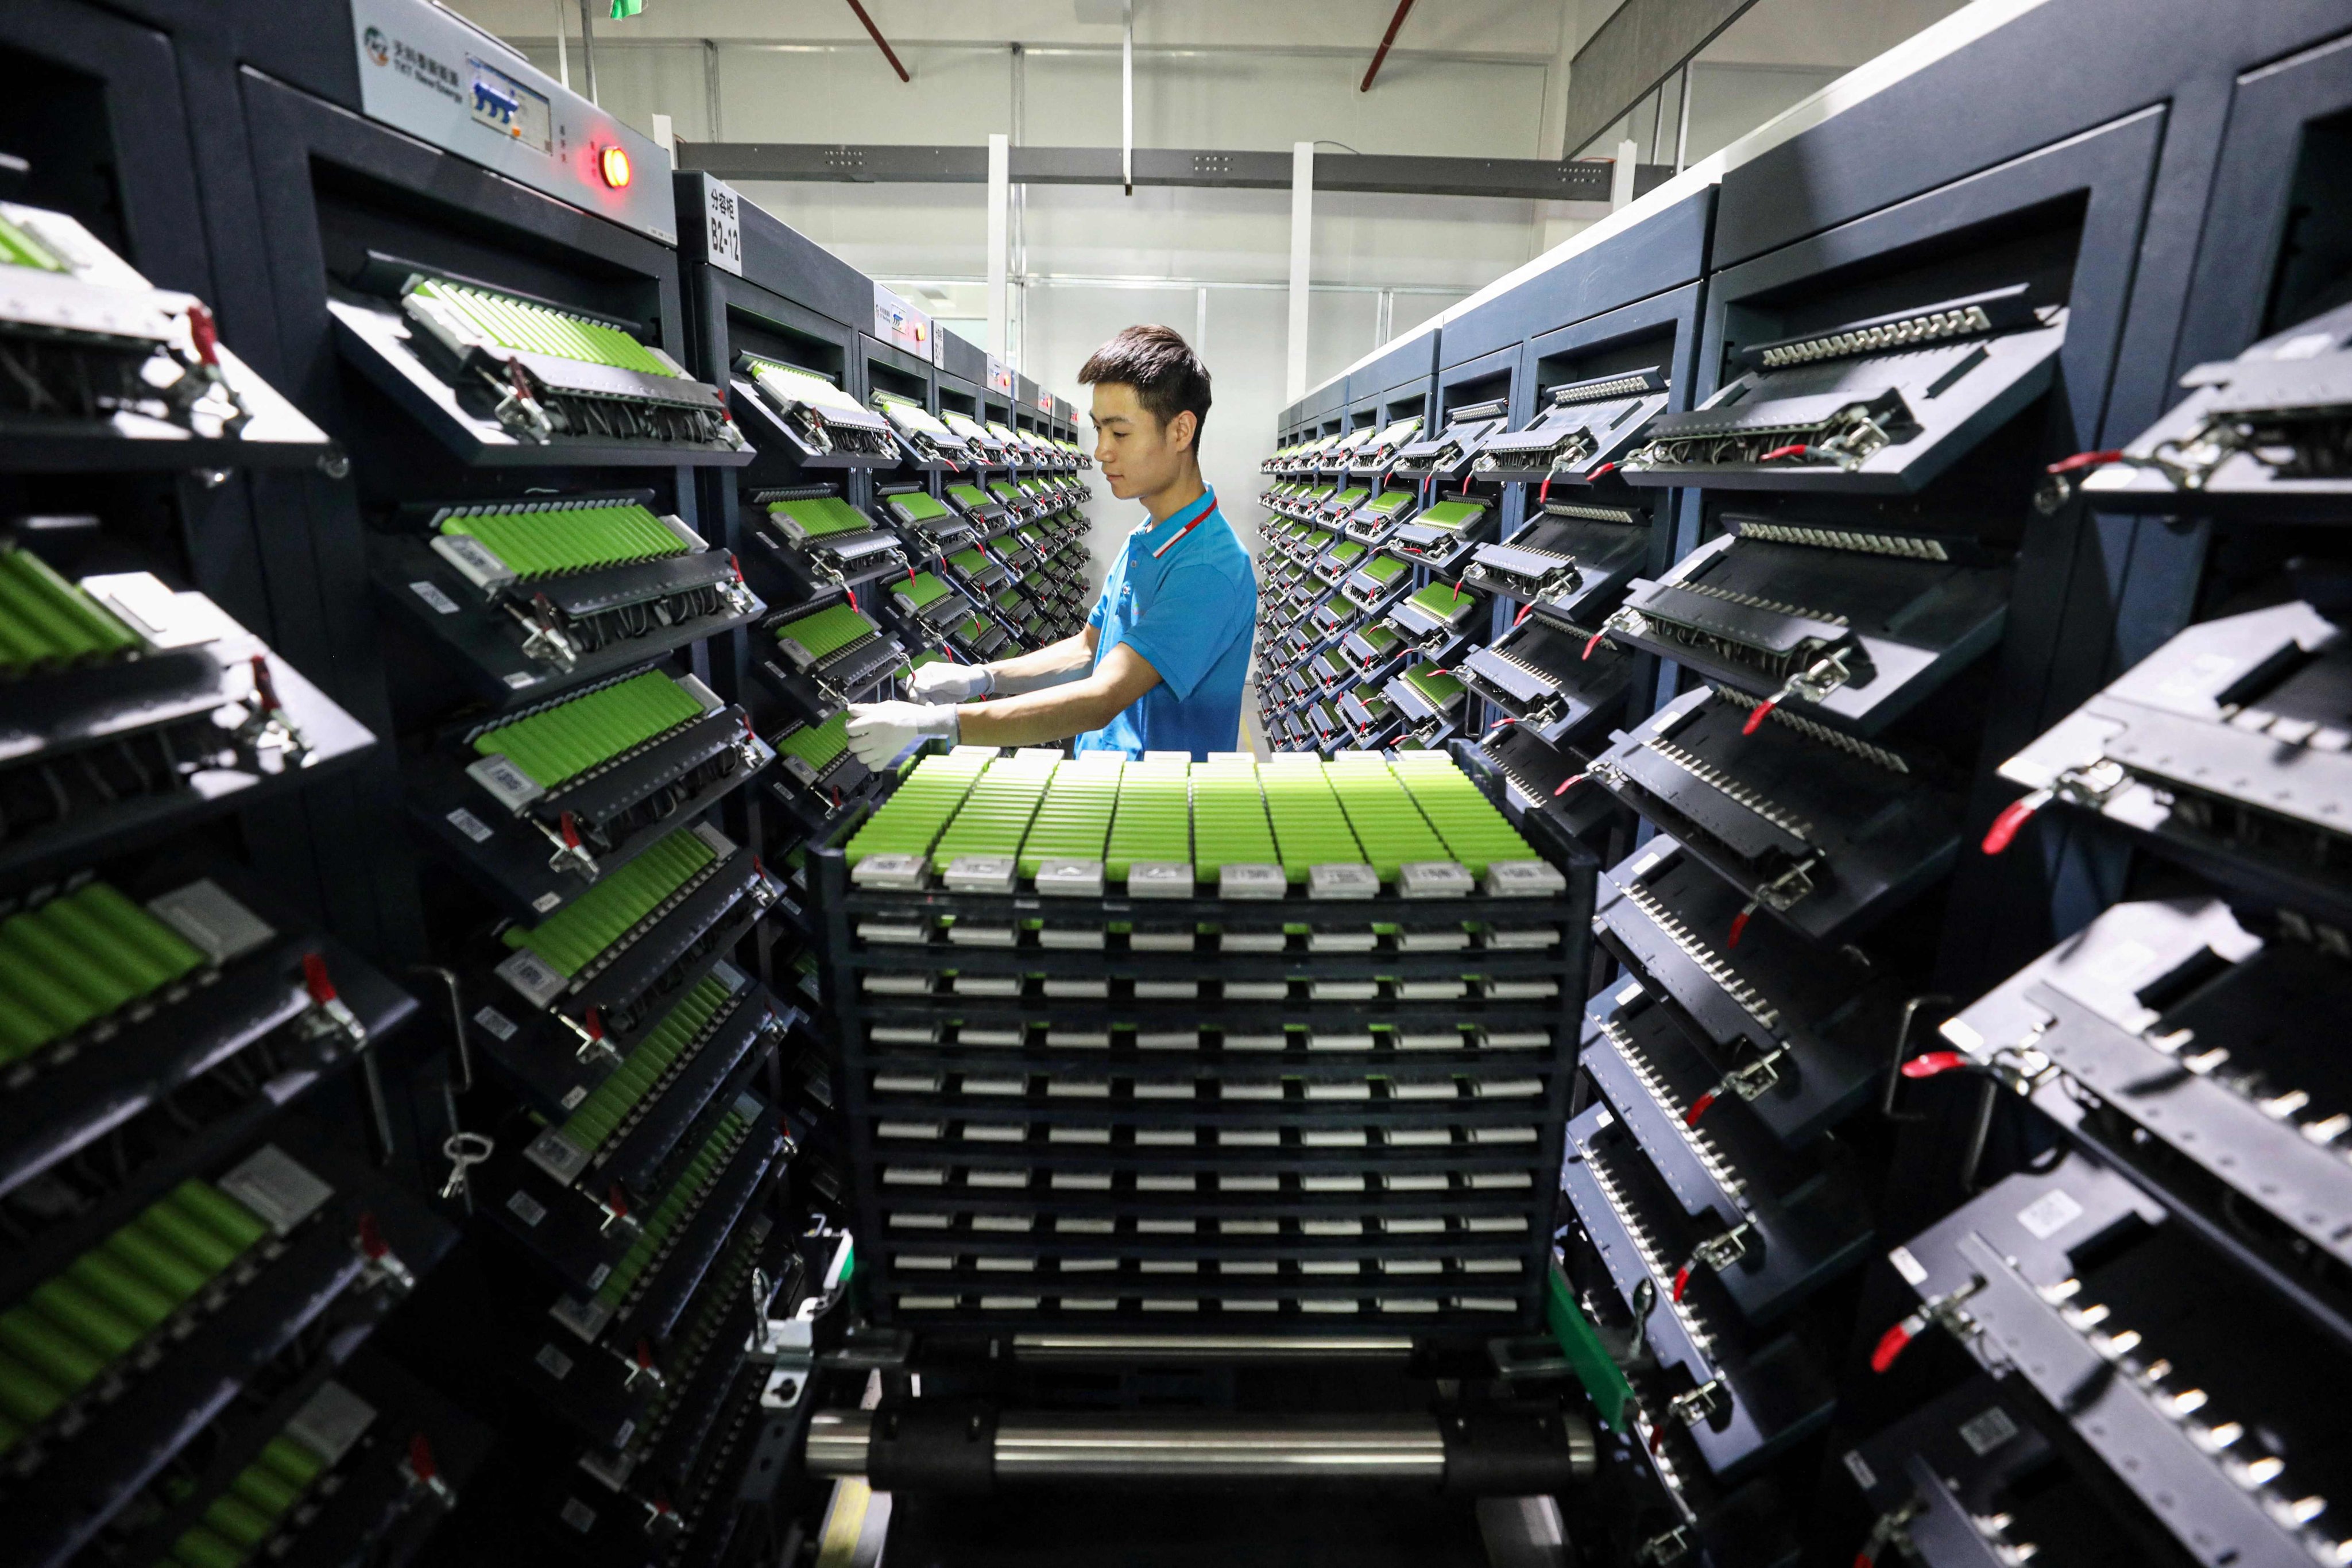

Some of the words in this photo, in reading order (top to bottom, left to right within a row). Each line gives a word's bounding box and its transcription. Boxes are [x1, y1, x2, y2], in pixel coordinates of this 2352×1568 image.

[711, 188, 734, 220] 分容柜
[711, 216, 739, 262] B2-12
